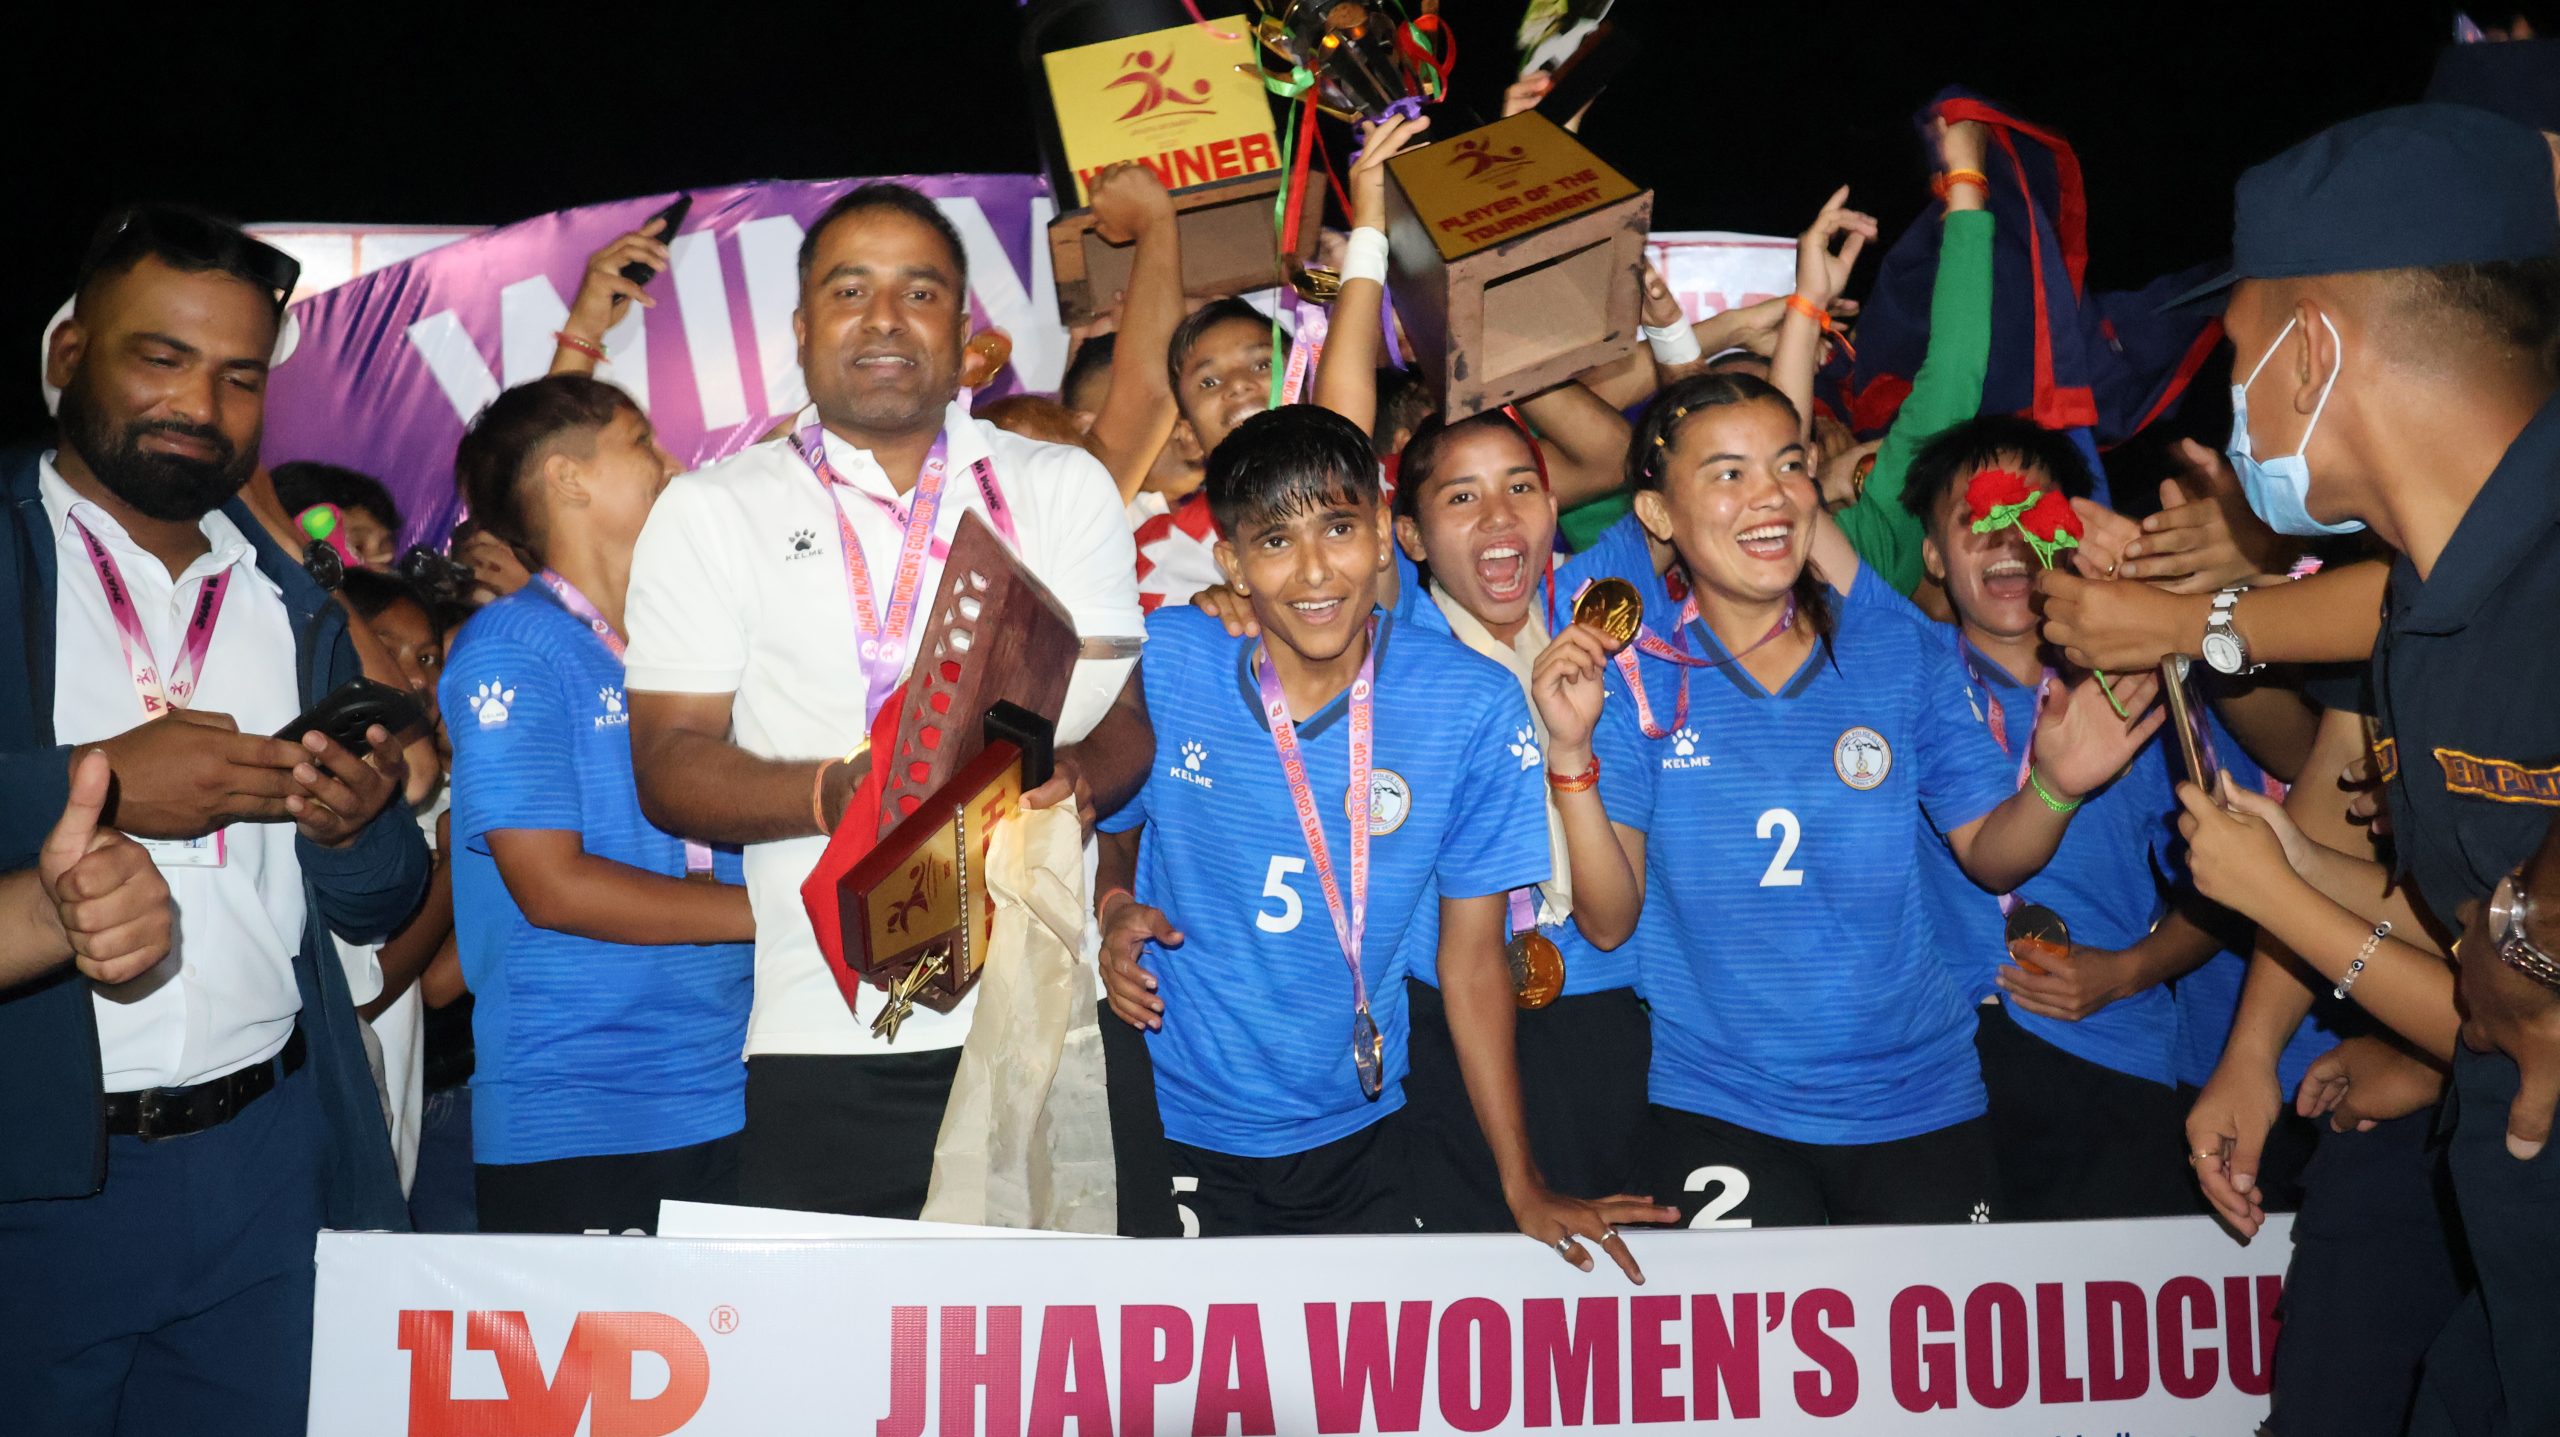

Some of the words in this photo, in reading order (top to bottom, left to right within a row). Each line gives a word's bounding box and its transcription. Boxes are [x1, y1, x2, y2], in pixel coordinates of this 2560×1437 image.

[1079, 132, 1277, 190] NNER
[1438, 196, 1523, 232] PLAYER
[1523, 184, 1551, 201] OF
[1554, 168, 1599, 190] THE
[1290, 346, 1306, 379] JHAPA
[785, 547, 824, 561] KELME
[886, 605, 908, 638] JHAPA
[907, 521, 929, 551] GOLD
[856, 599, 878, 635] JHAPA
[1353, 703, 1370, 732] 2082
[1275, 722, 1294, 752] 2082
[1353, 742, 1368, 765] CUP
[1170, 767, 1213, 789] KELME
[1285, 760, 1304, 784] CUP
[1662, 756, 1711, 769] KELME
[1353, 768, 1368, 801] GOLD
[2496, 767, 2560, 796] POLI
[1293, 784, 1312, 817] GOLD
[1304, 817, 1329, 874] WOMEN'S
[1353, 803, 1367, 857] WOMEN'S
[1756, 808, 1804, 887] 2
[1255, 855, 1306, 934] 5
[1321, 874, 1340, 910] JHAPA
[1353, 857, 1366, 898] JHAPA
[1684, 1166, 1752, 1229] 2
[876, 1304, 1276, 1437] JHAPA
[1304, 1288, 1859, 1434] WOMEN'S
